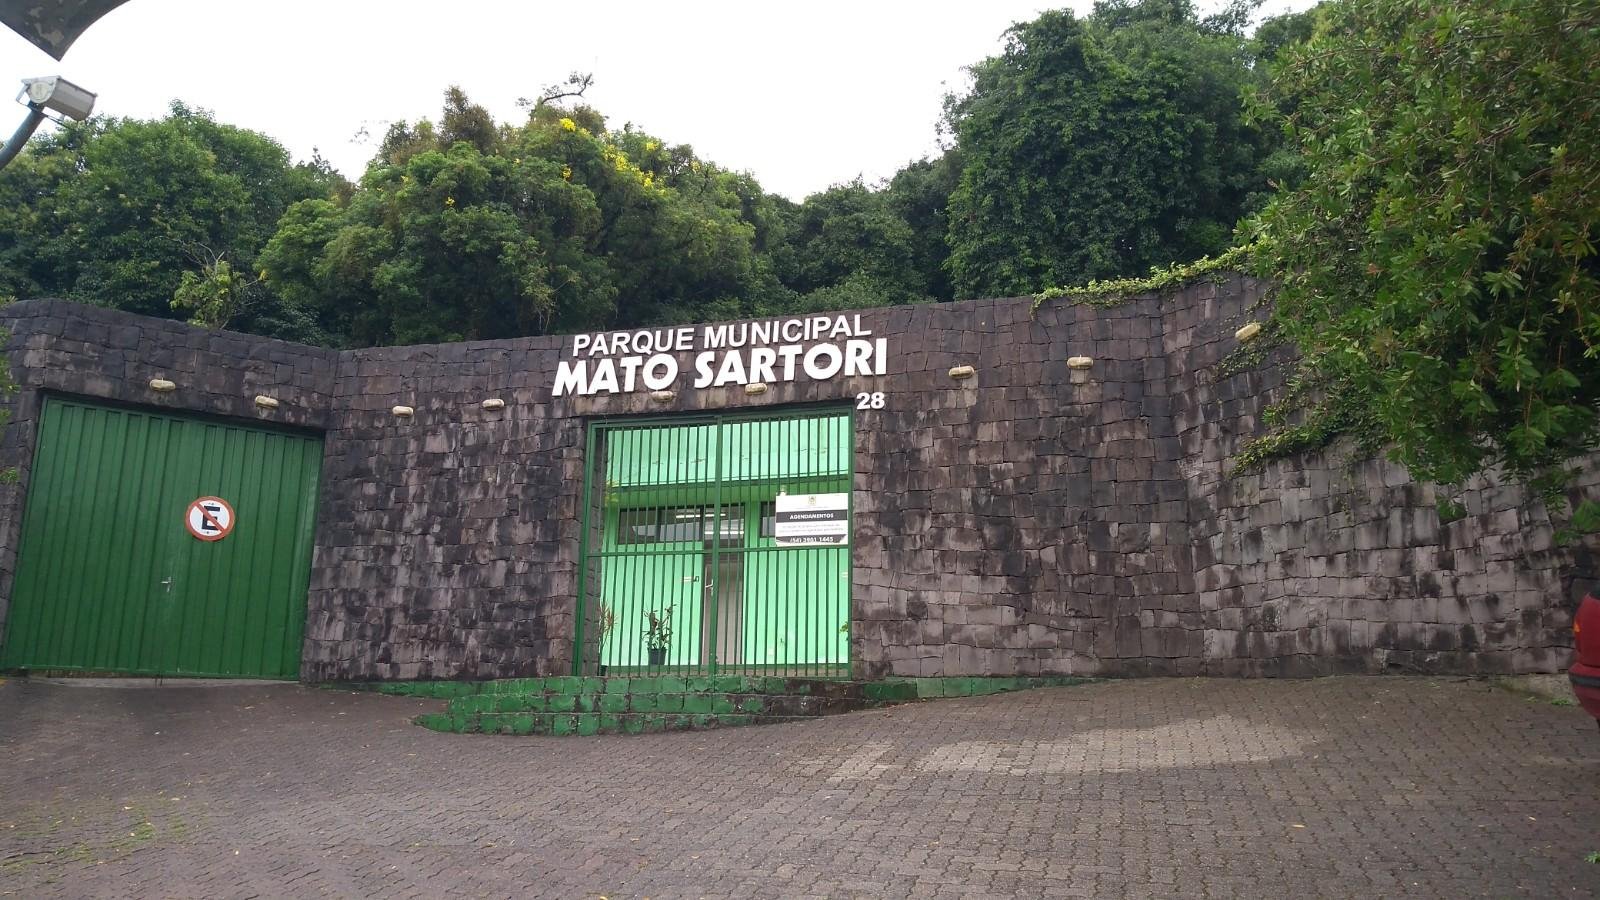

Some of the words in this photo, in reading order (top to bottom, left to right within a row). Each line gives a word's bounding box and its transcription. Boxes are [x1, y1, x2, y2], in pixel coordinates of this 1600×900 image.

[572, 327, 696, 357] PARQUE
[703, 314, 872, 349] MUNICIPAL
[551, 353, 679, 397] MATO
[694, 338, 888, 389] SARTORI
[856, 391, 885, 410] 28
[201, 505, 221, 531] E
